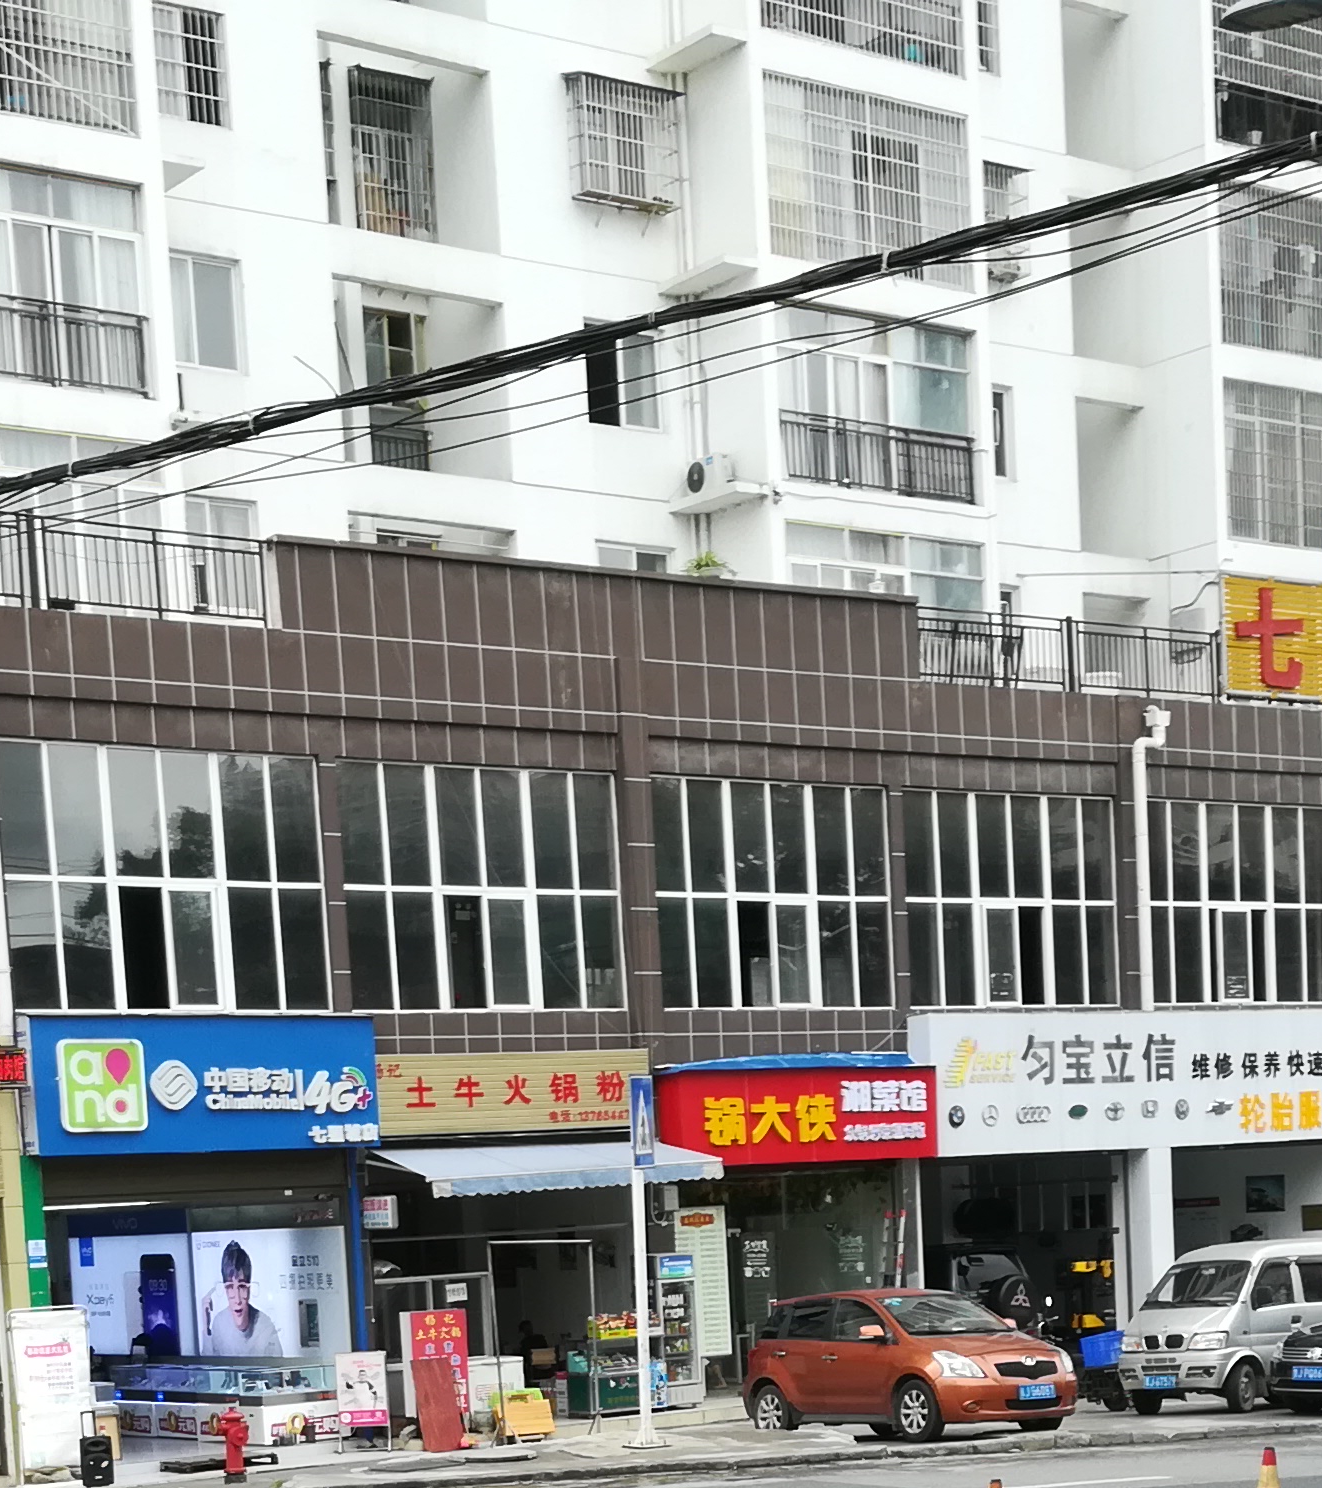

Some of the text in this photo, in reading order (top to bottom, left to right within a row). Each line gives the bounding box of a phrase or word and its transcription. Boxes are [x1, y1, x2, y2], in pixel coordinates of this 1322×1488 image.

[204, 1067, 295, 1093] 中国移动
[1021, 1033, 1176, 1086] 匀宝立信
[406, 1071, 625, 1108] 土牛火锅粉
[704, 1094, 837, 1146] 锅大侠
